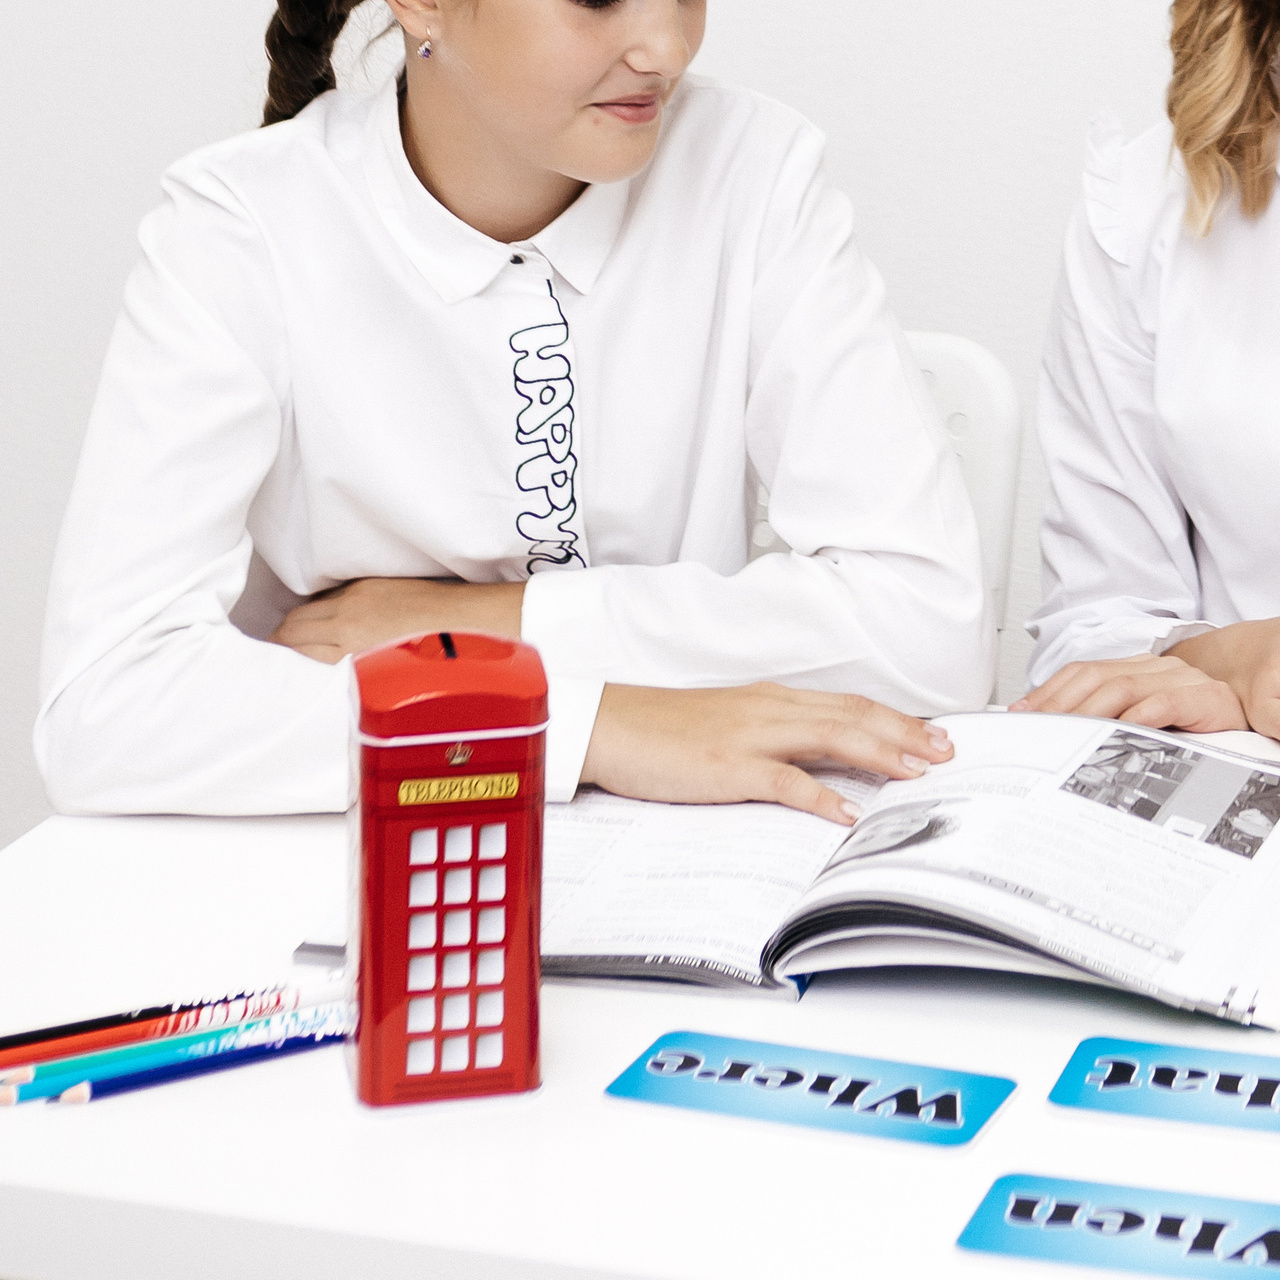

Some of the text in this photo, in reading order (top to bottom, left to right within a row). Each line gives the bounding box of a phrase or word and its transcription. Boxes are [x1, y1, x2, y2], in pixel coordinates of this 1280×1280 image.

[509, 323, 577, 542] HAPPY
[401, 775, 517, 803] TELEPHONE
[648, 1050, 966, 1128] Where
